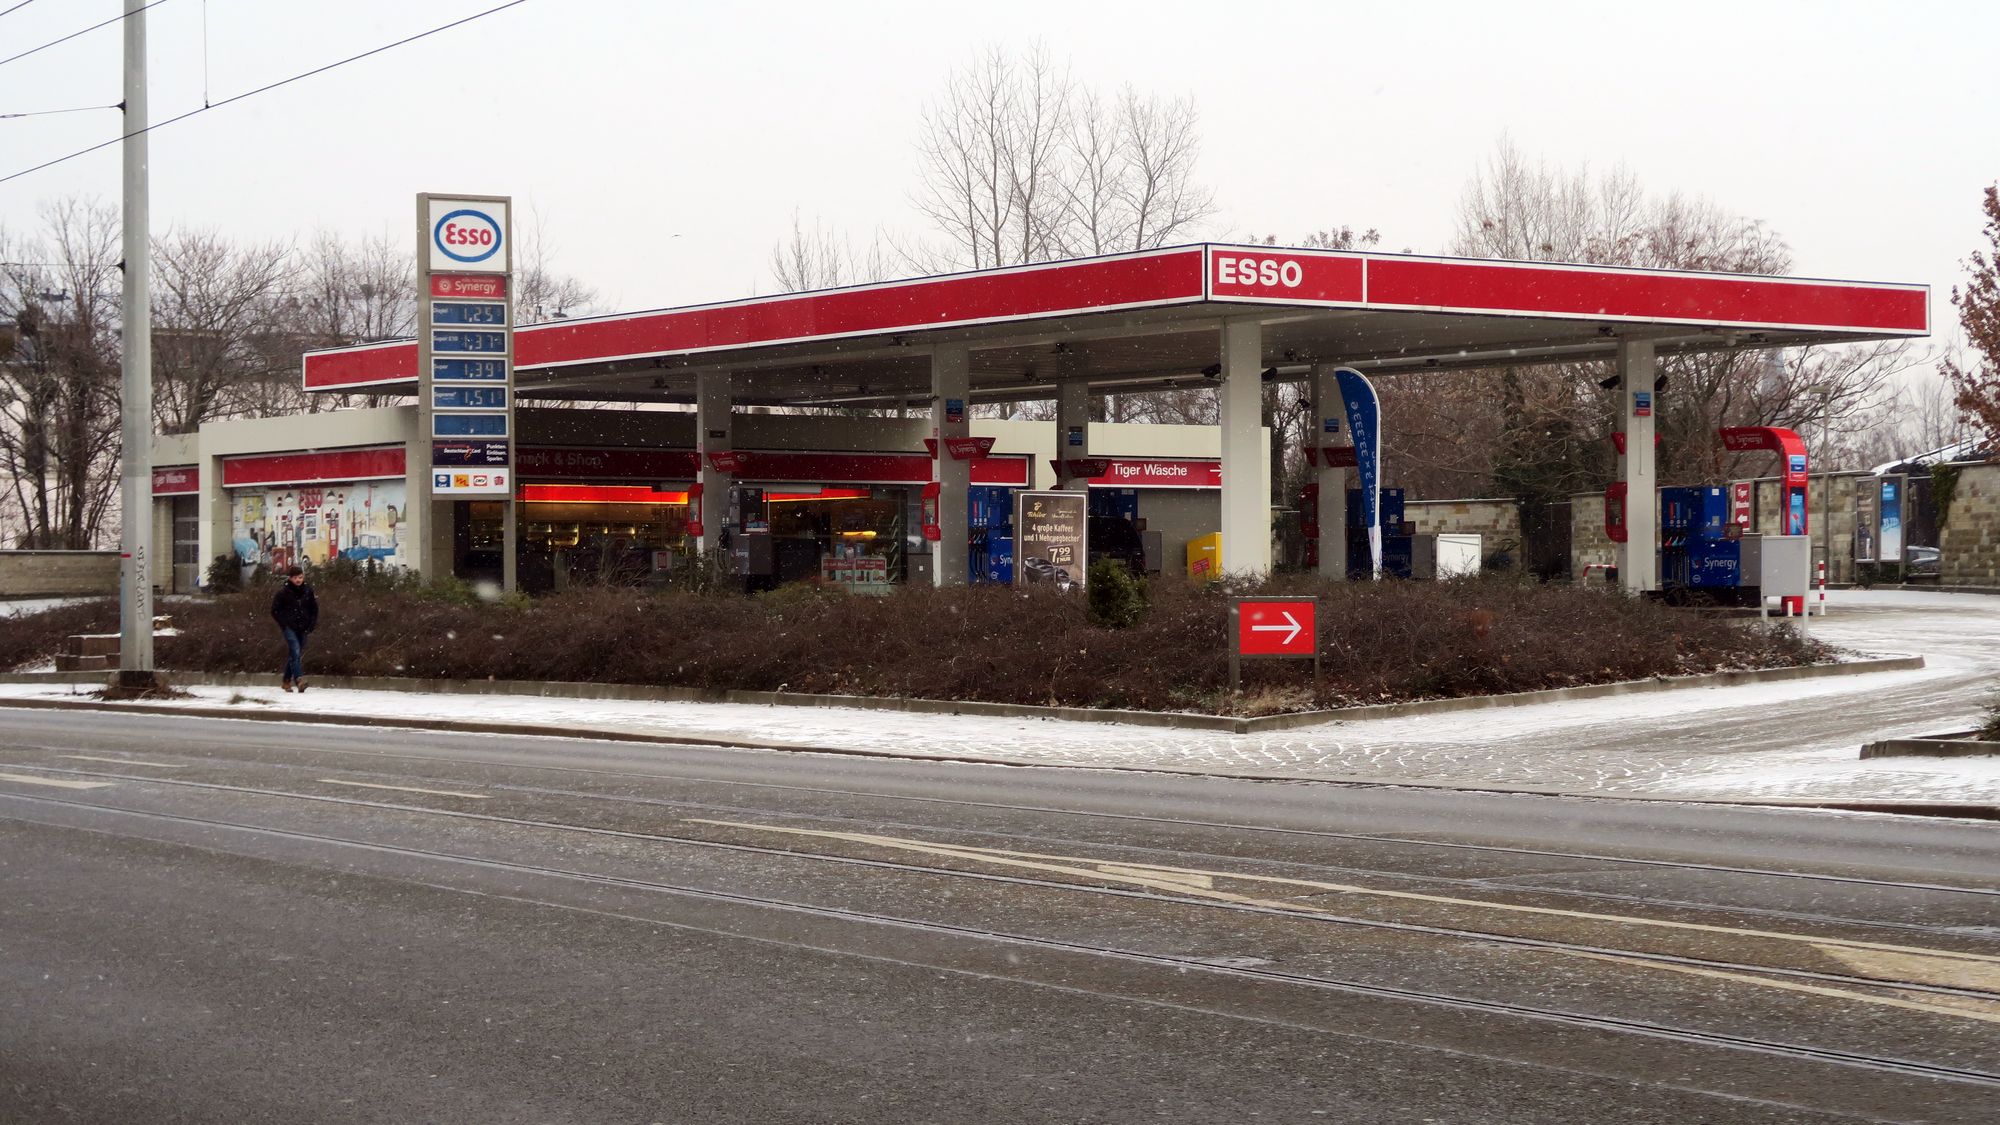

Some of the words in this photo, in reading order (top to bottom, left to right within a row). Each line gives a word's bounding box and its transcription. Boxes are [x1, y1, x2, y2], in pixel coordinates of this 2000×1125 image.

[445, 223, 492, 246] Esso
[1218, 257, 1303, 288] ESSO
[454, 280, 496, 294] Synergy
[567, 452, 602, 468] Shop
[1112, 463, 1140, 478] Tiger
[1143, 463, 1188, 476] Wäsche
[1038, 524, 1053, 533] große
[1704, 557, 1737, 570] Synergy
